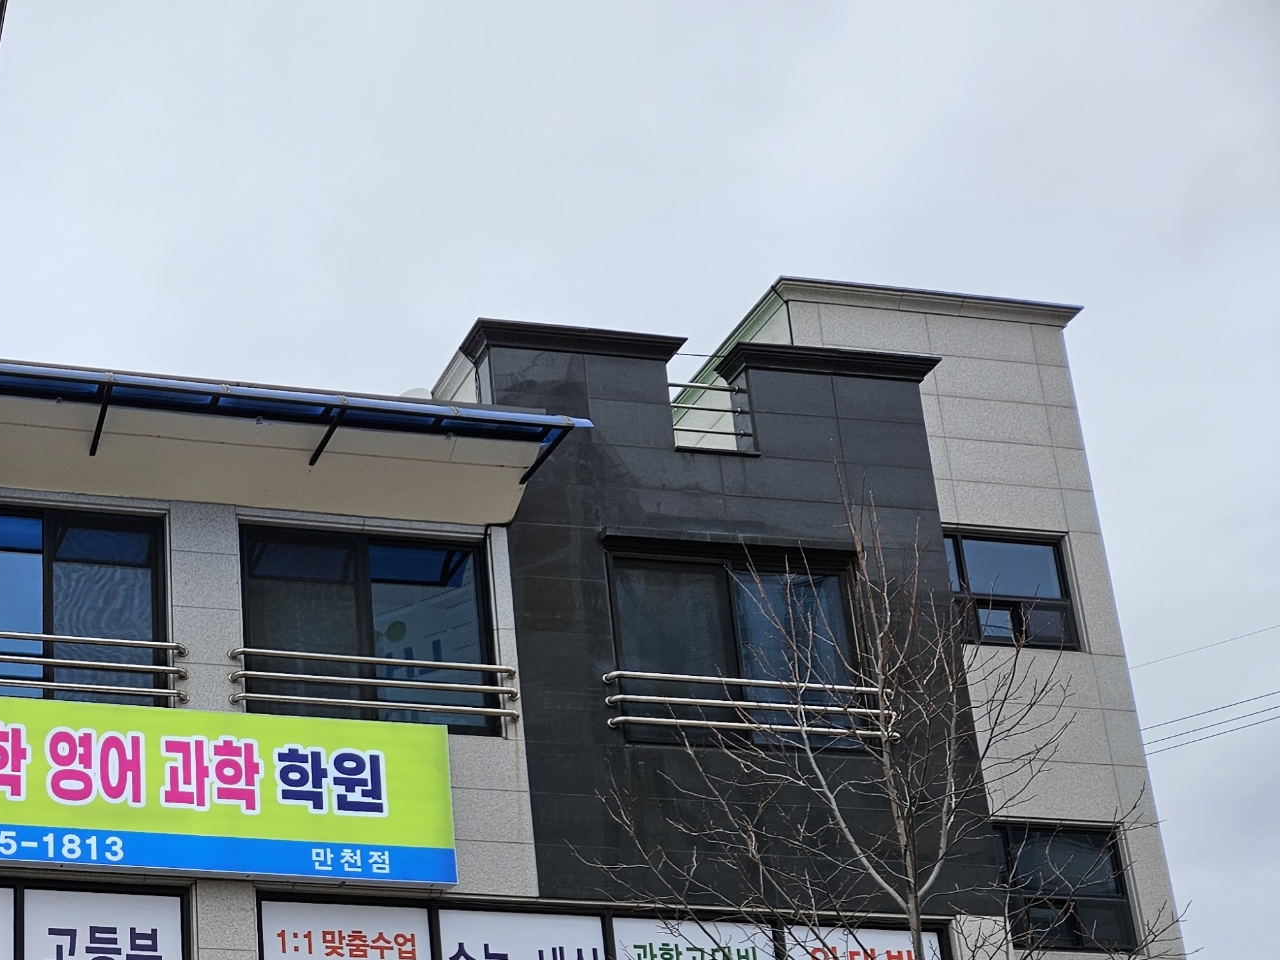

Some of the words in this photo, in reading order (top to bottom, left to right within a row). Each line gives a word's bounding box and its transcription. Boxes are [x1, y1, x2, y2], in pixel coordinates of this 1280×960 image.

[49, 729, 142, 803] 영어
[165, 740, 260, 810] 과학
[278, 747, 386, 813] 학원
[311, 847, 391, 874] 만천점
[277, 929, 313, 955] 1:1
[322, 930, 417, 960] 맞춤수업
